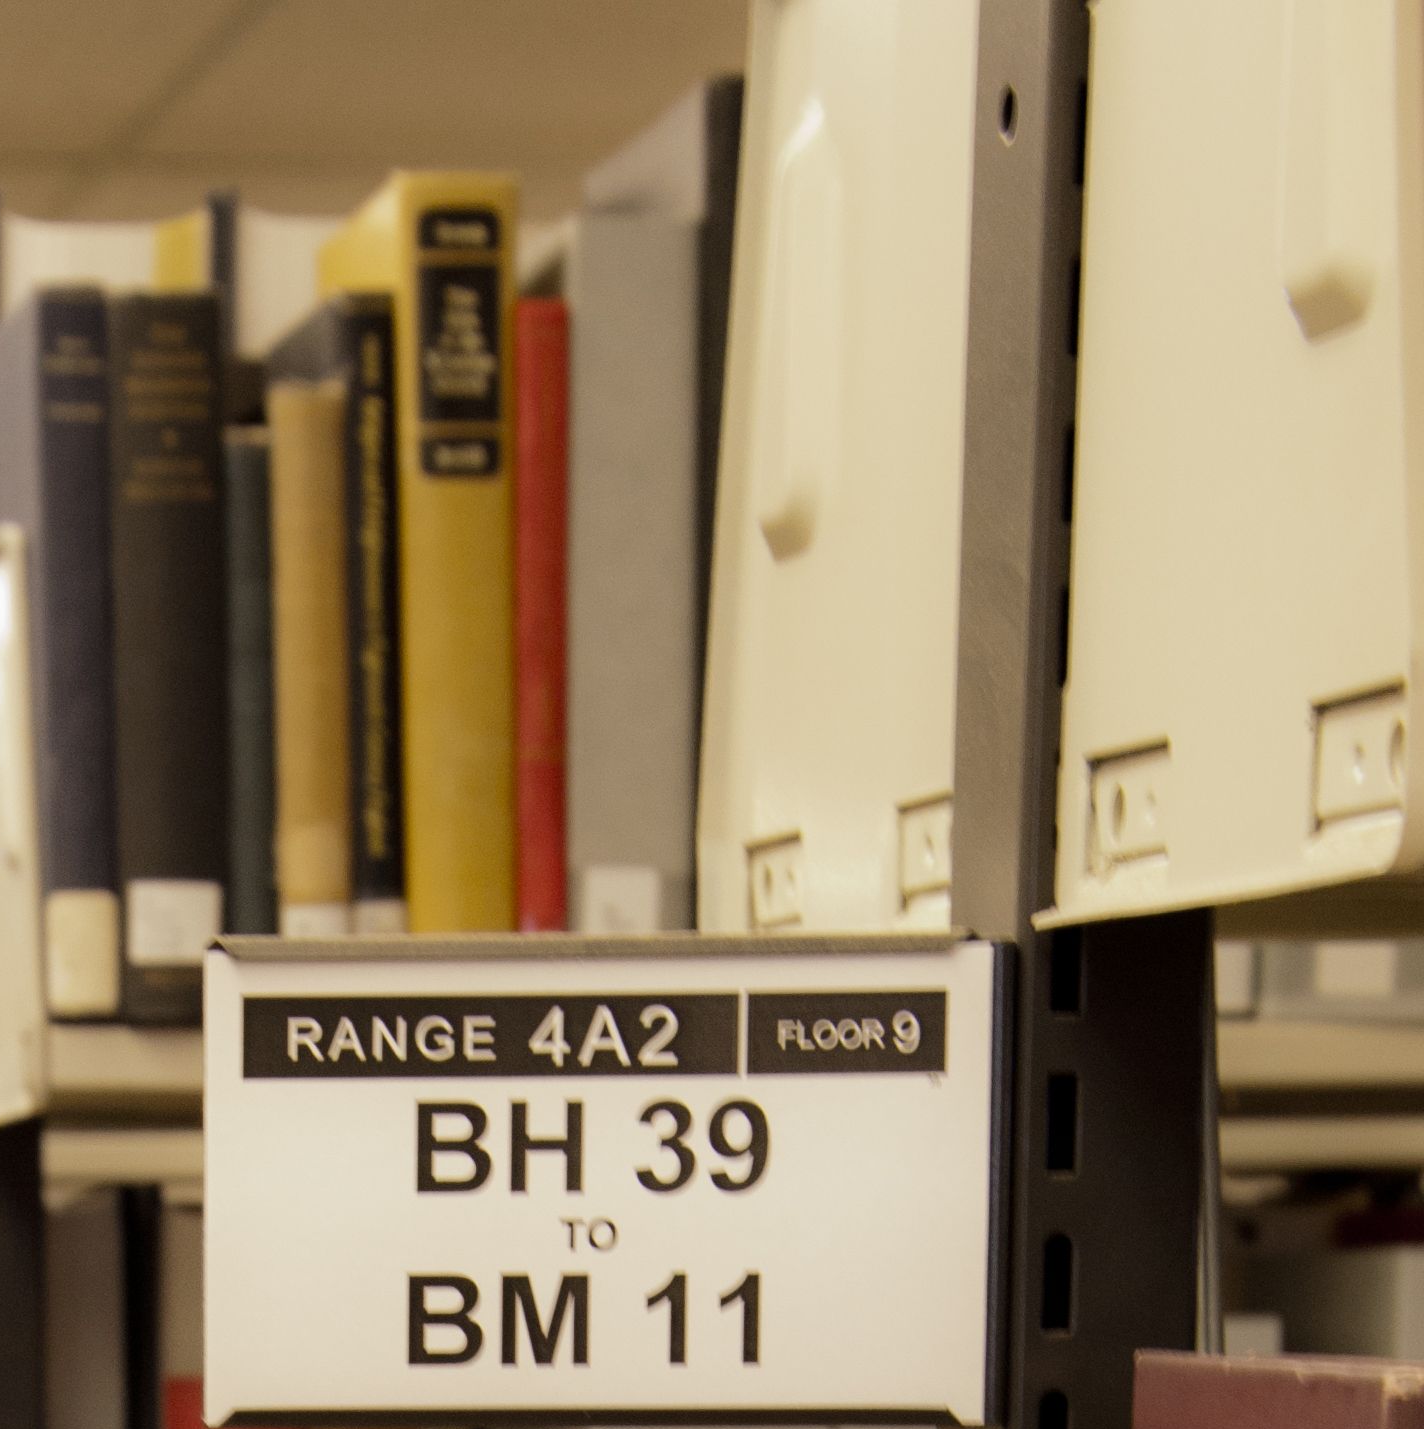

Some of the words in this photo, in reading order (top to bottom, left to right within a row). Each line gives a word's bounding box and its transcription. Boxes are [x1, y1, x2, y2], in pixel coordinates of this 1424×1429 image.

[285, 1015, 497, 1063] RANGE
[527, 1004, 681, 1068] 4A2
[776, 1018, 886, 1052] FLOOR
[892, 1009, 921, 1055] 9
[414, 1098, 585, 1194] BH
[634, 1098, 771, 1194] 39
[560, 1218, 618, 1251] TO
[406, 1271, 591, 1366] BM
[644, 1271, 762, 1366] 11
